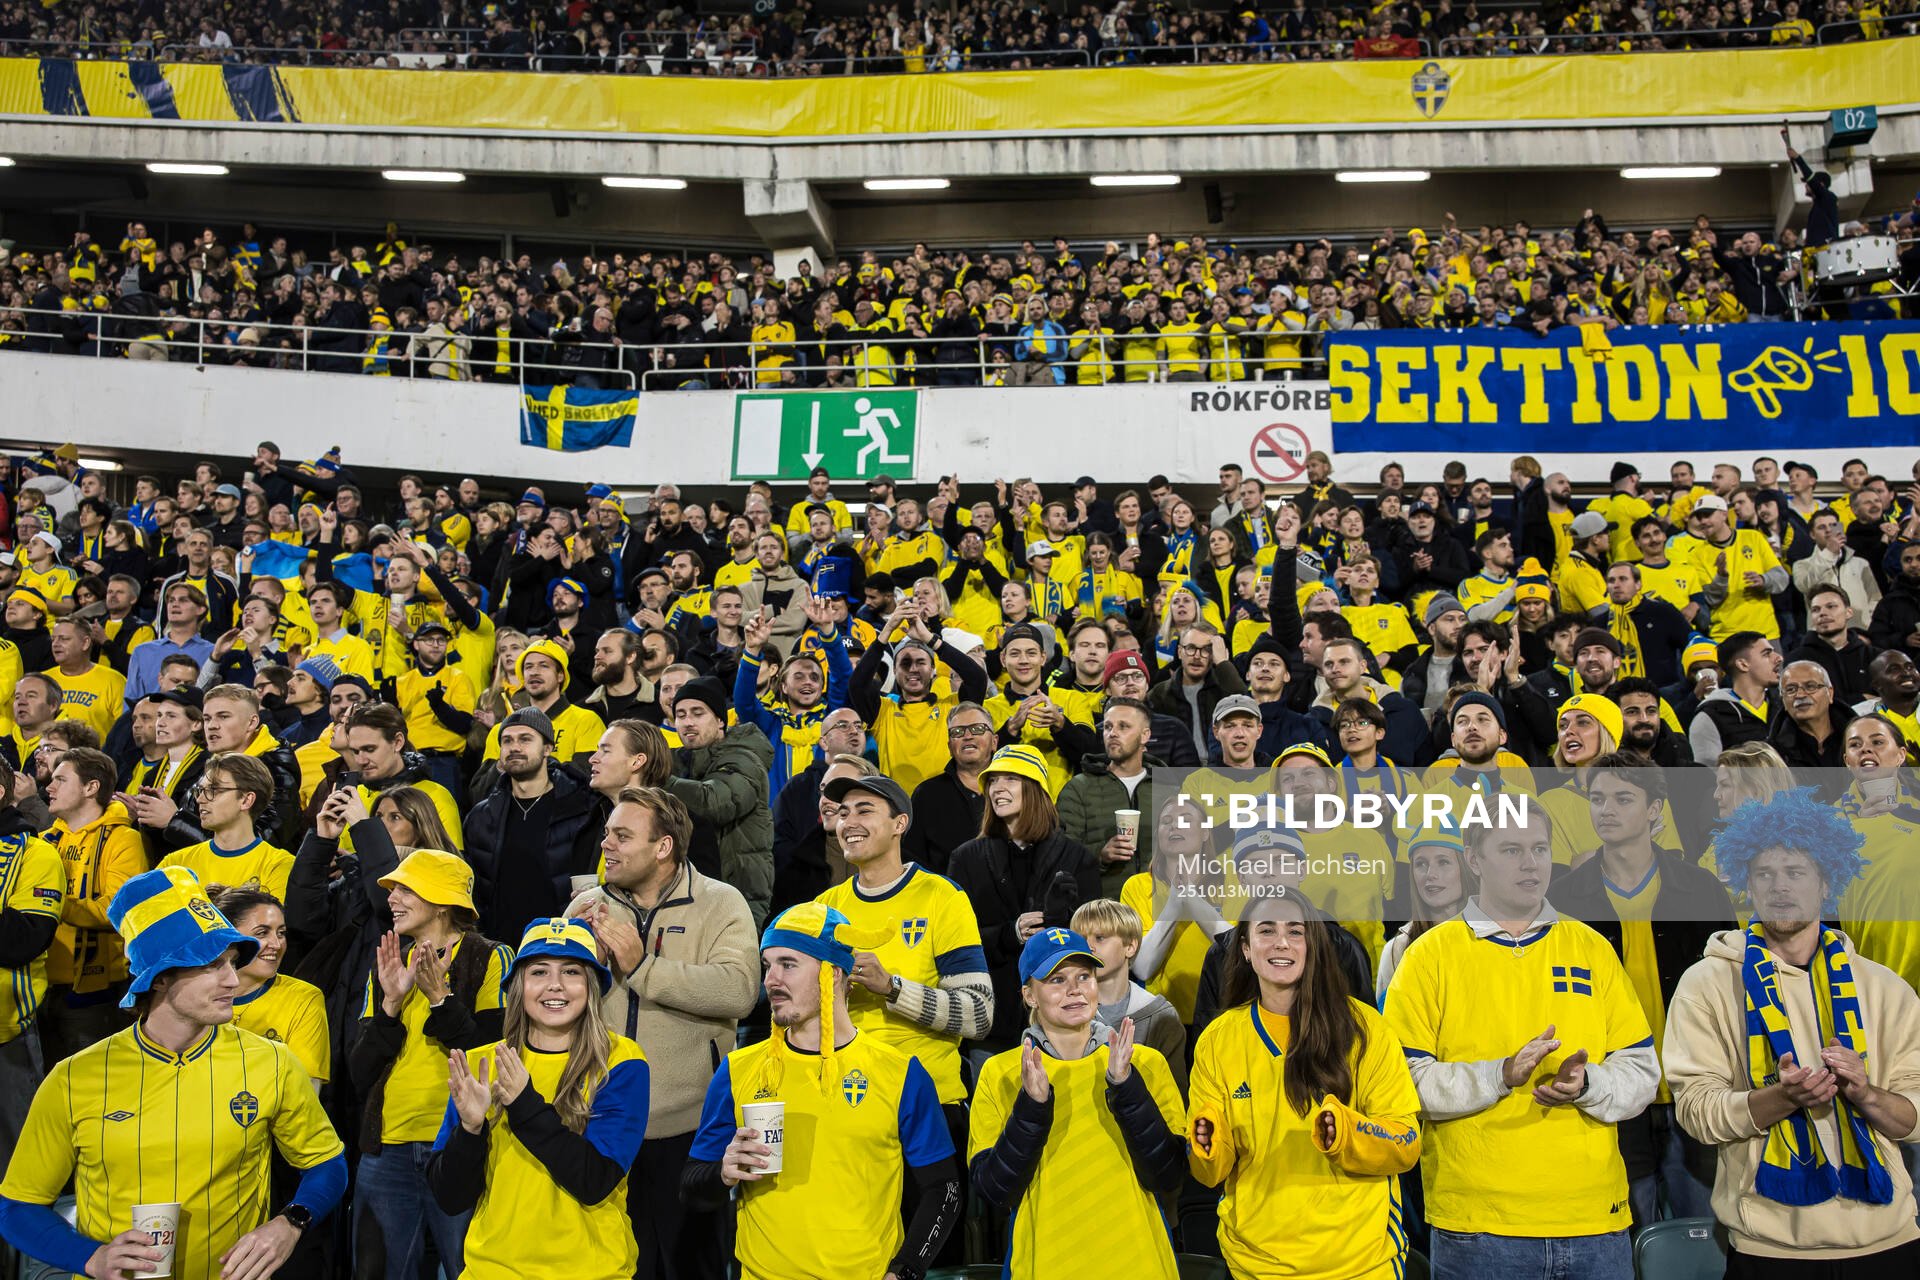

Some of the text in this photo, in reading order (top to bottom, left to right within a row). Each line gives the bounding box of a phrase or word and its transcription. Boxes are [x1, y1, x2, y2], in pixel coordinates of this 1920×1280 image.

[1844, 108, 1867, 130] Ö2
[1328, 333, 1920, 424] SEKTION 10
[1190, 385, 1331, 412] RÖKFÖRB
[147, 1230, 175, 1246] T21
